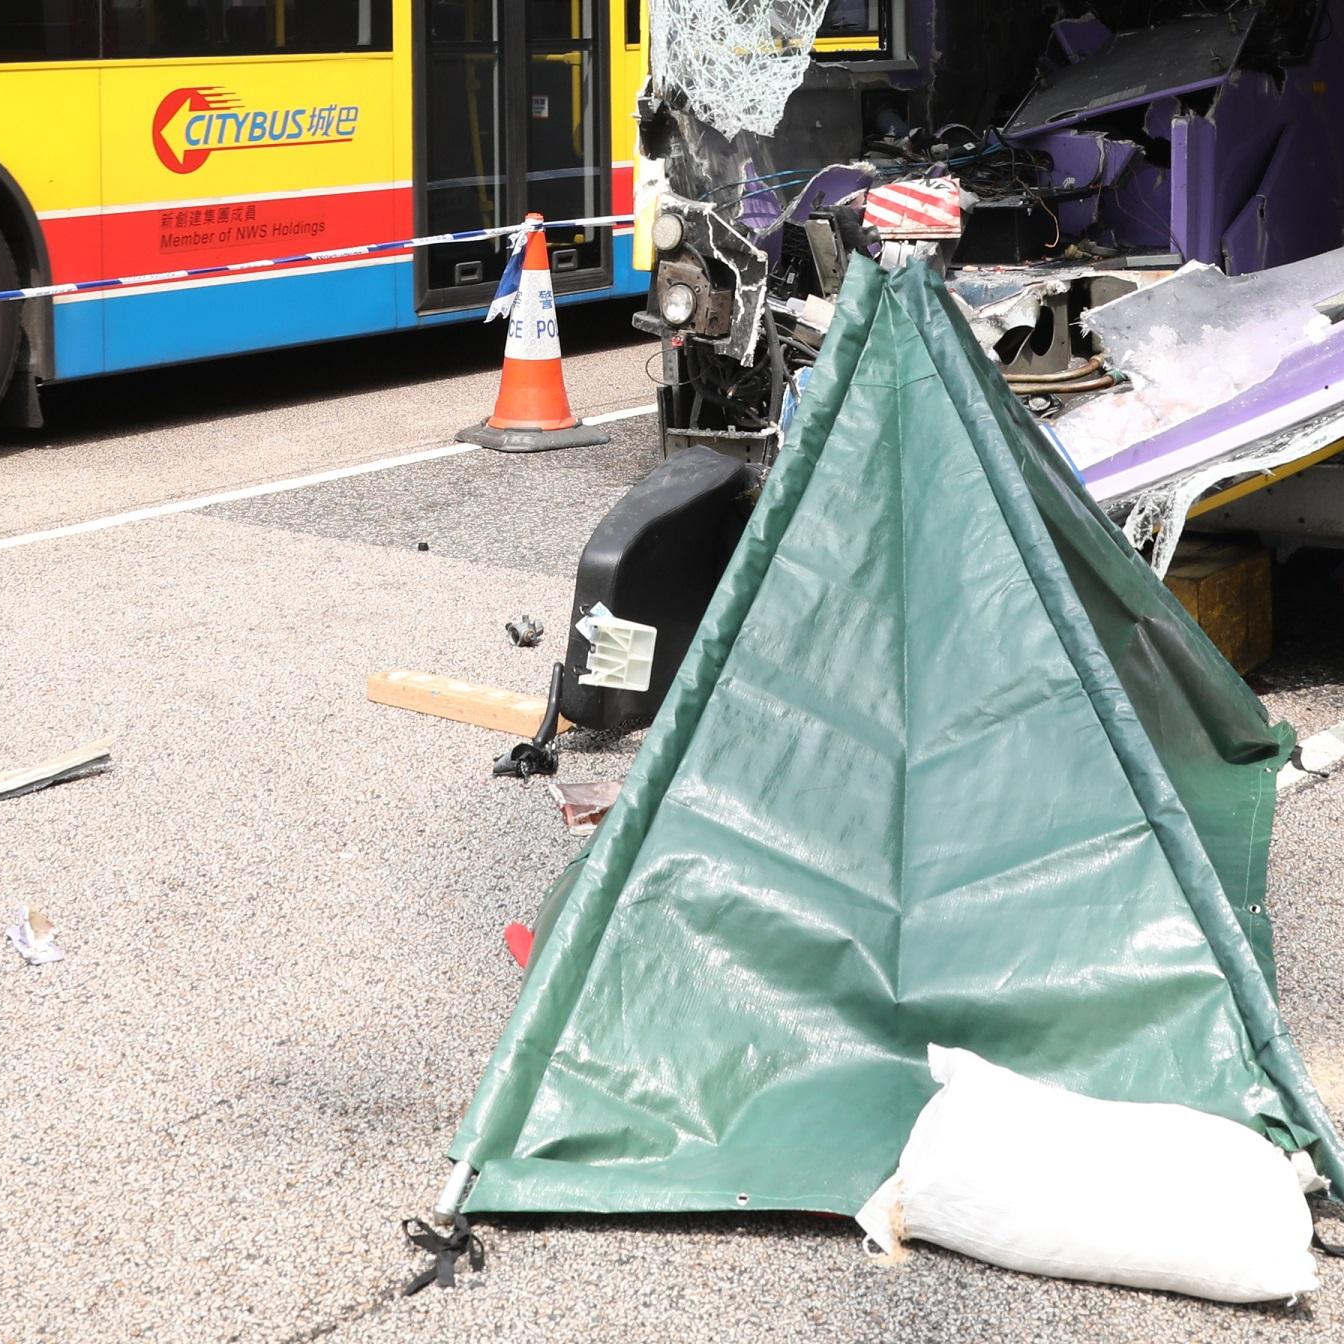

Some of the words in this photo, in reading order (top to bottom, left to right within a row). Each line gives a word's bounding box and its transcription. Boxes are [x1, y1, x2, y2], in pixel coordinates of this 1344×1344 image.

[185, 109, 307, 146] CITYBUS
[307, 103, 360, 138] 城巴
[160, 205, 257, 229] 新創建集團成員
[160, 230, 215, 249] Member
[218, 227, 234, 243] of
[235, 223, 268, 241] NWS
[272, 219, 326, 239] Holdings
